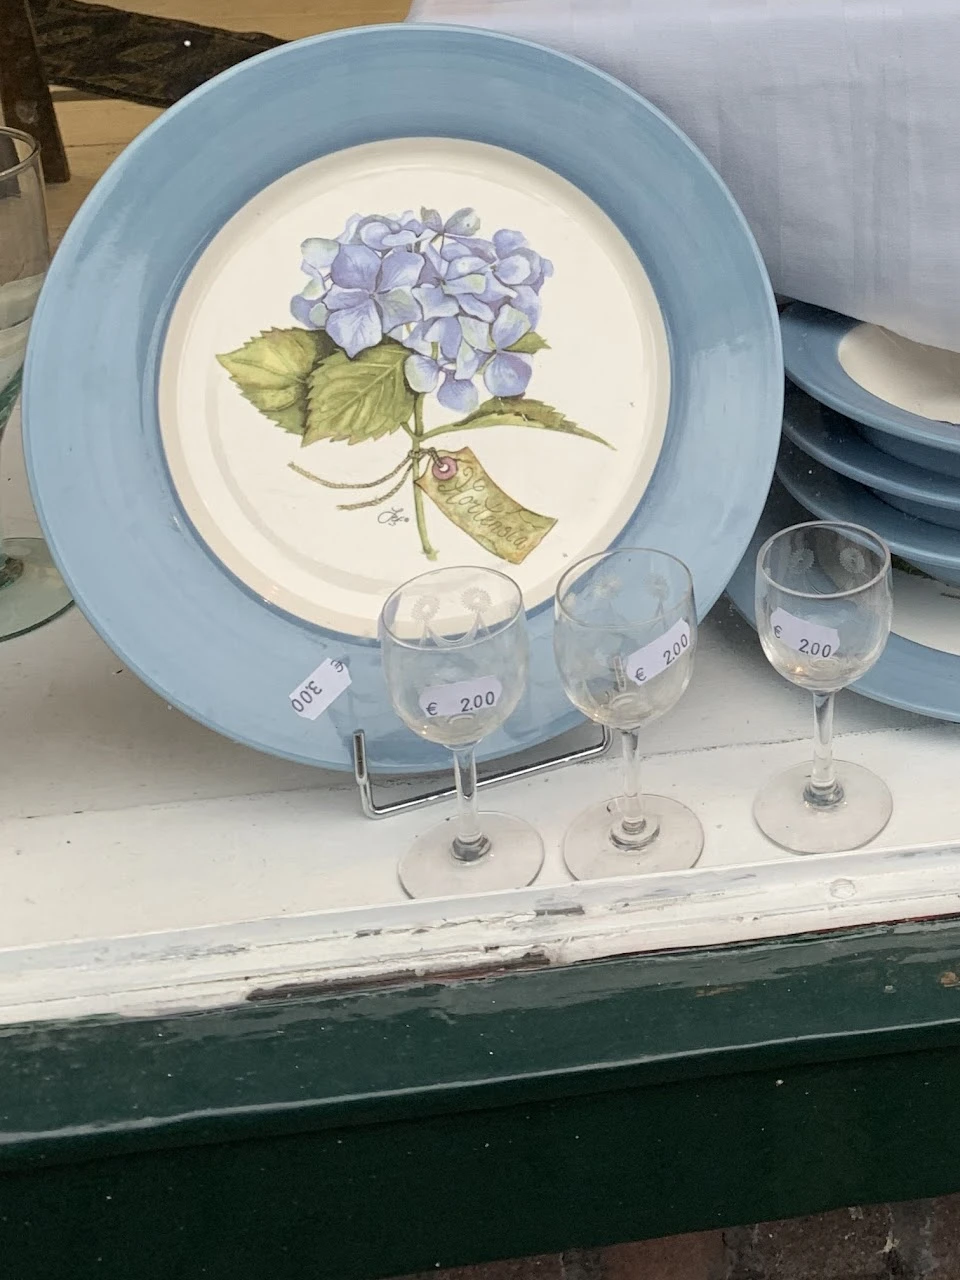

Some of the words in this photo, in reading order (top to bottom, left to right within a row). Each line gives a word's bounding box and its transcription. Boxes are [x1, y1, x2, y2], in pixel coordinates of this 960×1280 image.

[634, 667, 647, 682] €
[662, 633, 688, 666] 2.00
[773, 624, 783, 639] €
[798, 638, 832, 658] 2.00
[330, 659, 344, 673] €
[291, 680, 323, 713] 3.00
[425, 701, 438, 716] €
[460, 690, 495, 713] 2.00
